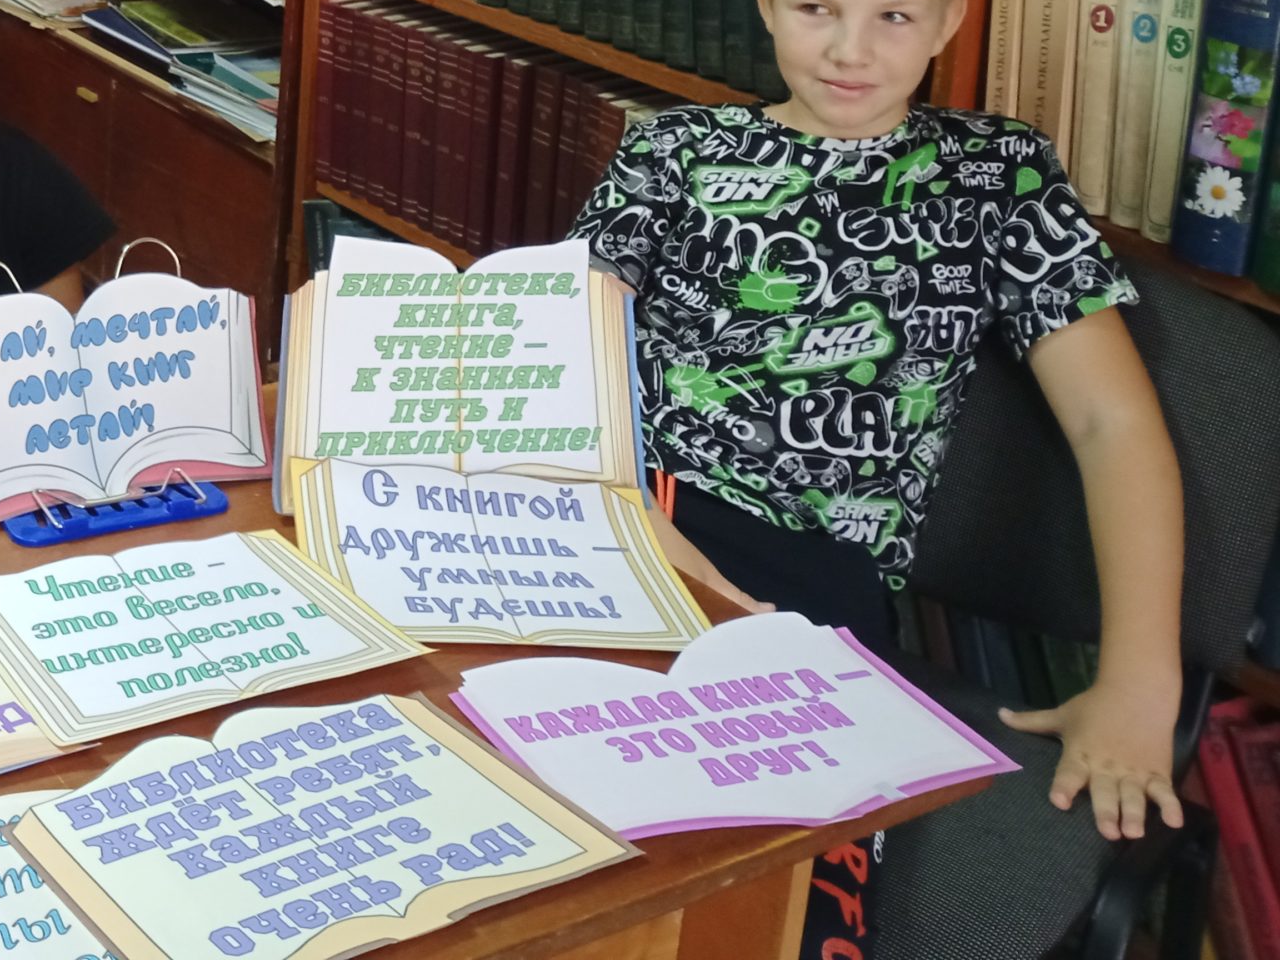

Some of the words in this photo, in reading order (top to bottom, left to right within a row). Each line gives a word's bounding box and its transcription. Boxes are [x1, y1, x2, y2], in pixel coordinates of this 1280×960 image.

[1096, 9, 1109, 27] 1
[1139, 19, 1151, 36] 2
[1173, 34, 1185, 54] 3
[698, 170, 792, 185] GAME
[958, 161, 1005, 173] GOOD
[701, 182, 774, 202] ON
[952, 174, 1006, 190] TIMES
[931, 264, 972, 278] GOOD
[336, 272, 581, 299] БИБЛИОТЕКА,
[928, 278, 976, 294] TIMES
[393, 302, 524, 330] КНИГА,
[373, 334, 515, 360] ЧТЕНИЕ
[801, 320, 879, 351] ON
[787, 340, 887, 368] GAME
[8, 367, 93, 408] МИР
[108, 349, 195, 390] КНИГ
[350, 367, 382, 392] К
[389, 365, 566, 391] ЗНАНИЯМ
[388, 397, 489, 424] ПУТЬ
[498, 396, 529, 422] И
[314, 426, 604, 458] ПРИКЛЮЧЕНИЕ!
[362, 469, 400, 507] С
[828, 501, 891, 522] GAME
[830, 520, 880, 543] ON
[25, 560, 195, 603] Чтение
[31, 610, 118, 640] это
[125, 581, 281, 622] весело,
[40, 611, 285, 675] интересно
[292, 601, 328, 621] и
[116, 631, 310, 699] полезно!
[503, 690, 699, 743] КАЖДАЯ
[688, 668, 840, 717] КНИГА
[605, 727, 698, 765] ЭТО
[691, 696, 857, 748] НОВЫЙ
[56, 702, 404, 830] БИБЛИОТЕКА
[698, 739, 841, 788] ДРУГ!
[83, 790, 254, 866] ЖДЁТ
[256, 734, 442, 806] РЕБЯТ,
[167, 771, 433, 880] КАЖДЫЙ
[240, 816, 431, 898] КНИГЕ
[207, 875, 403, 957] ОЧЕНЬ
[400, 822, 536, 886] РАД!
